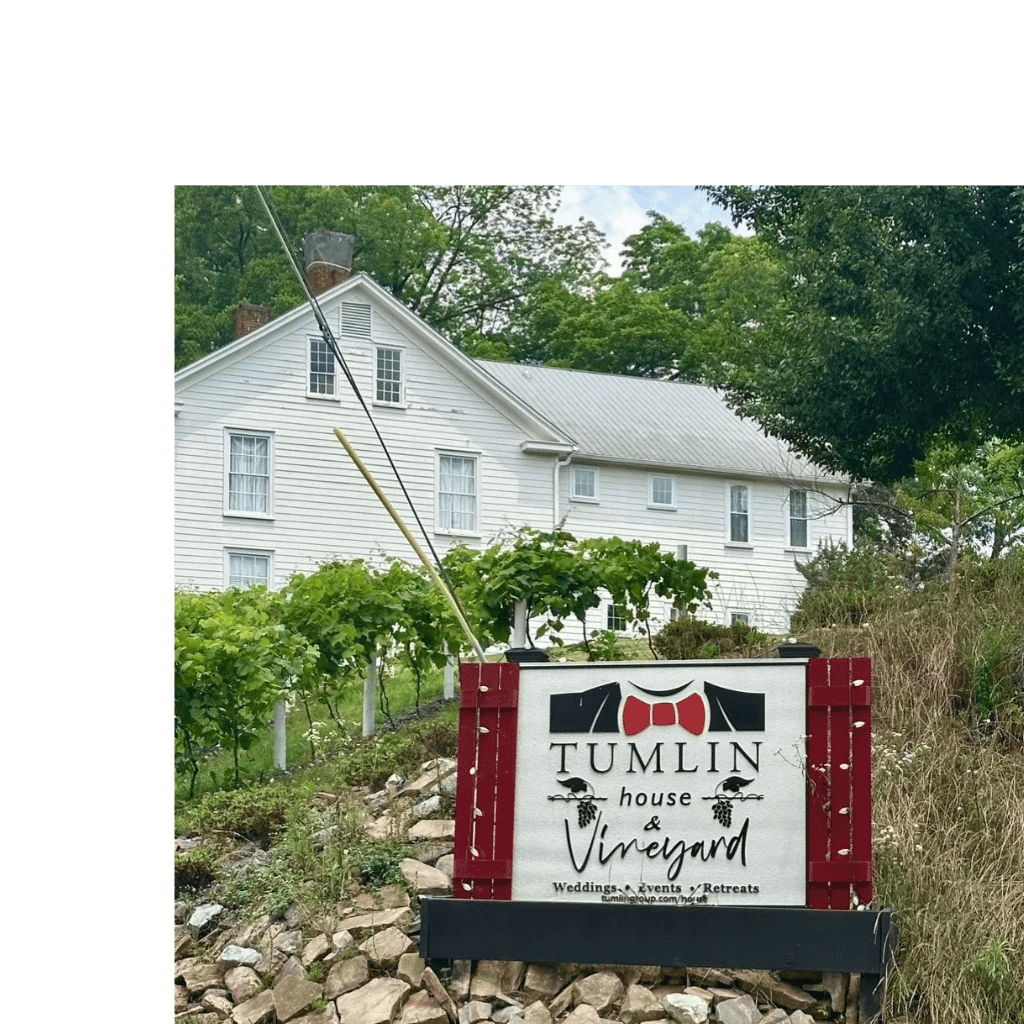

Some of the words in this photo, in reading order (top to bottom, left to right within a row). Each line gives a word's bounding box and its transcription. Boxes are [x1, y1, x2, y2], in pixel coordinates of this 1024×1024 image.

[549, 741, 763, 774] TUMLIN
[619, 786, 692, 807] house
[644, 815, 661, 831] &
[564, 811, 750, 881] Vineyard
[552, 882, 617, 894] Weddings
[638, 882, 682, 893] Events
[702, 883, 760, 894] Retreats
